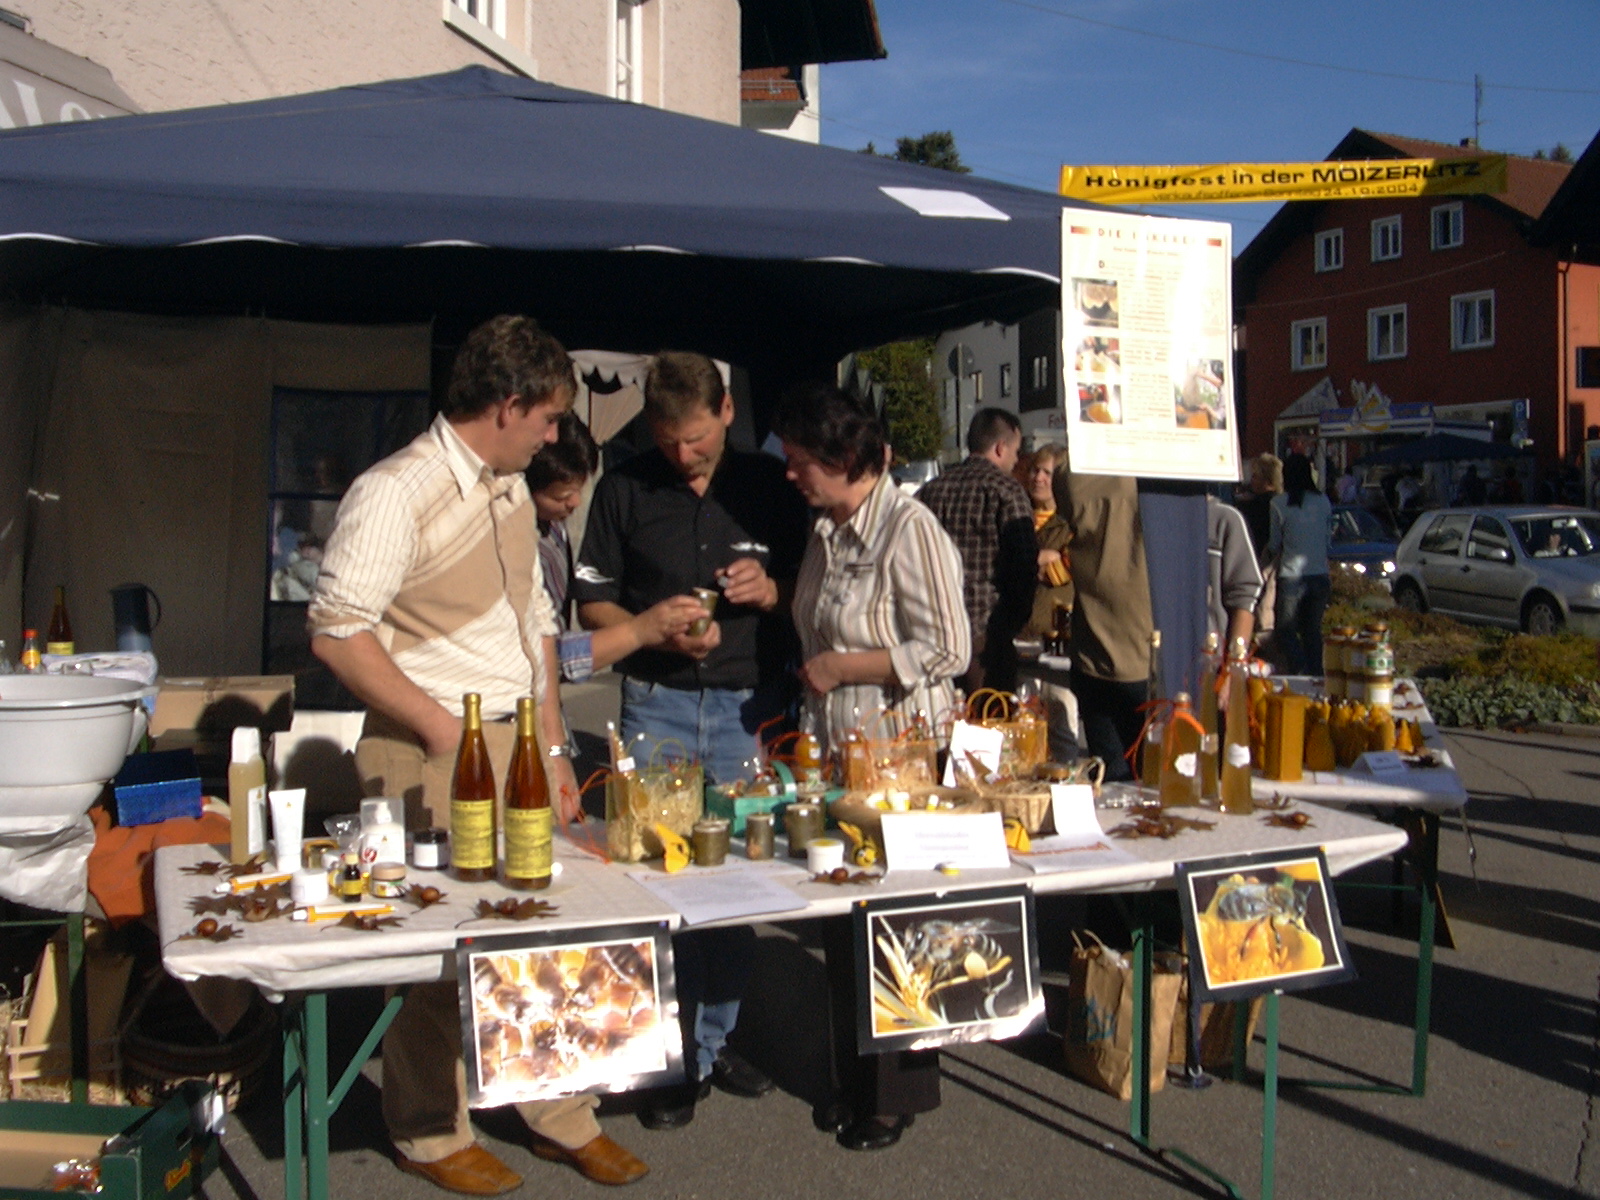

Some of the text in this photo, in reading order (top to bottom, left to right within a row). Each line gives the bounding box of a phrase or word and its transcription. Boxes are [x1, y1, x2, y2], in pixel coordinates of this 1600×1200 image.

[1085, 162, 1482, 189] Honigfest in der MOIZERLITZ
[1324, 183, 1418, 197] 24.10.2004
[1098, 227, 1121, 239] DIE
